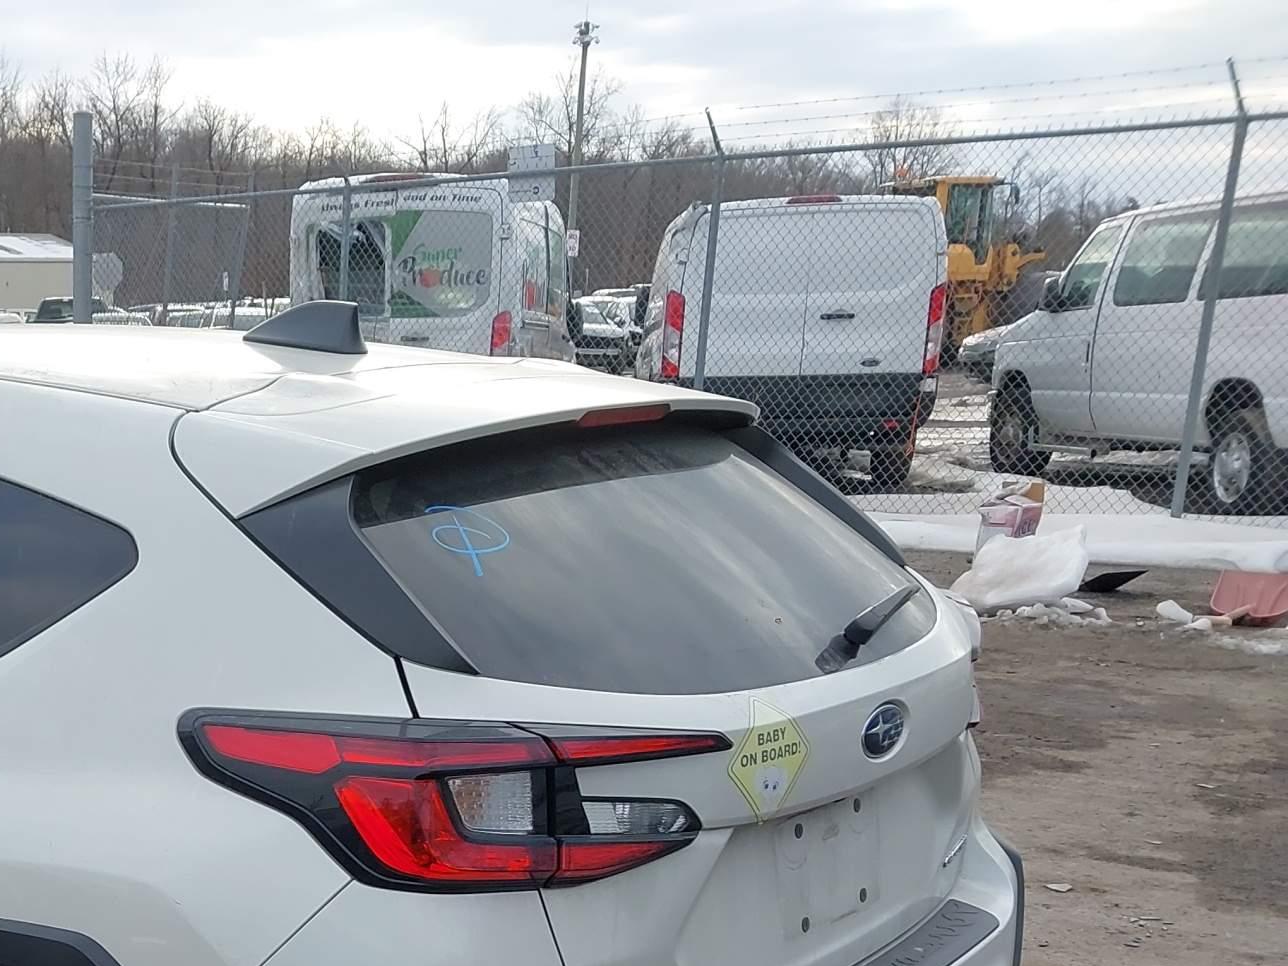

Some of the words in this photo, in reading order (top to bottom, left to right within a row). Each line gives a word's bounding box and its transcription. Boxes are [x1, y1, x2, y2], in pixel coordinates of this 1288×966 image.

[757, 726, 787, 746] BABY
[740, 752, 758, 768] ON
[761, 741, 801, 763] BOARD!
